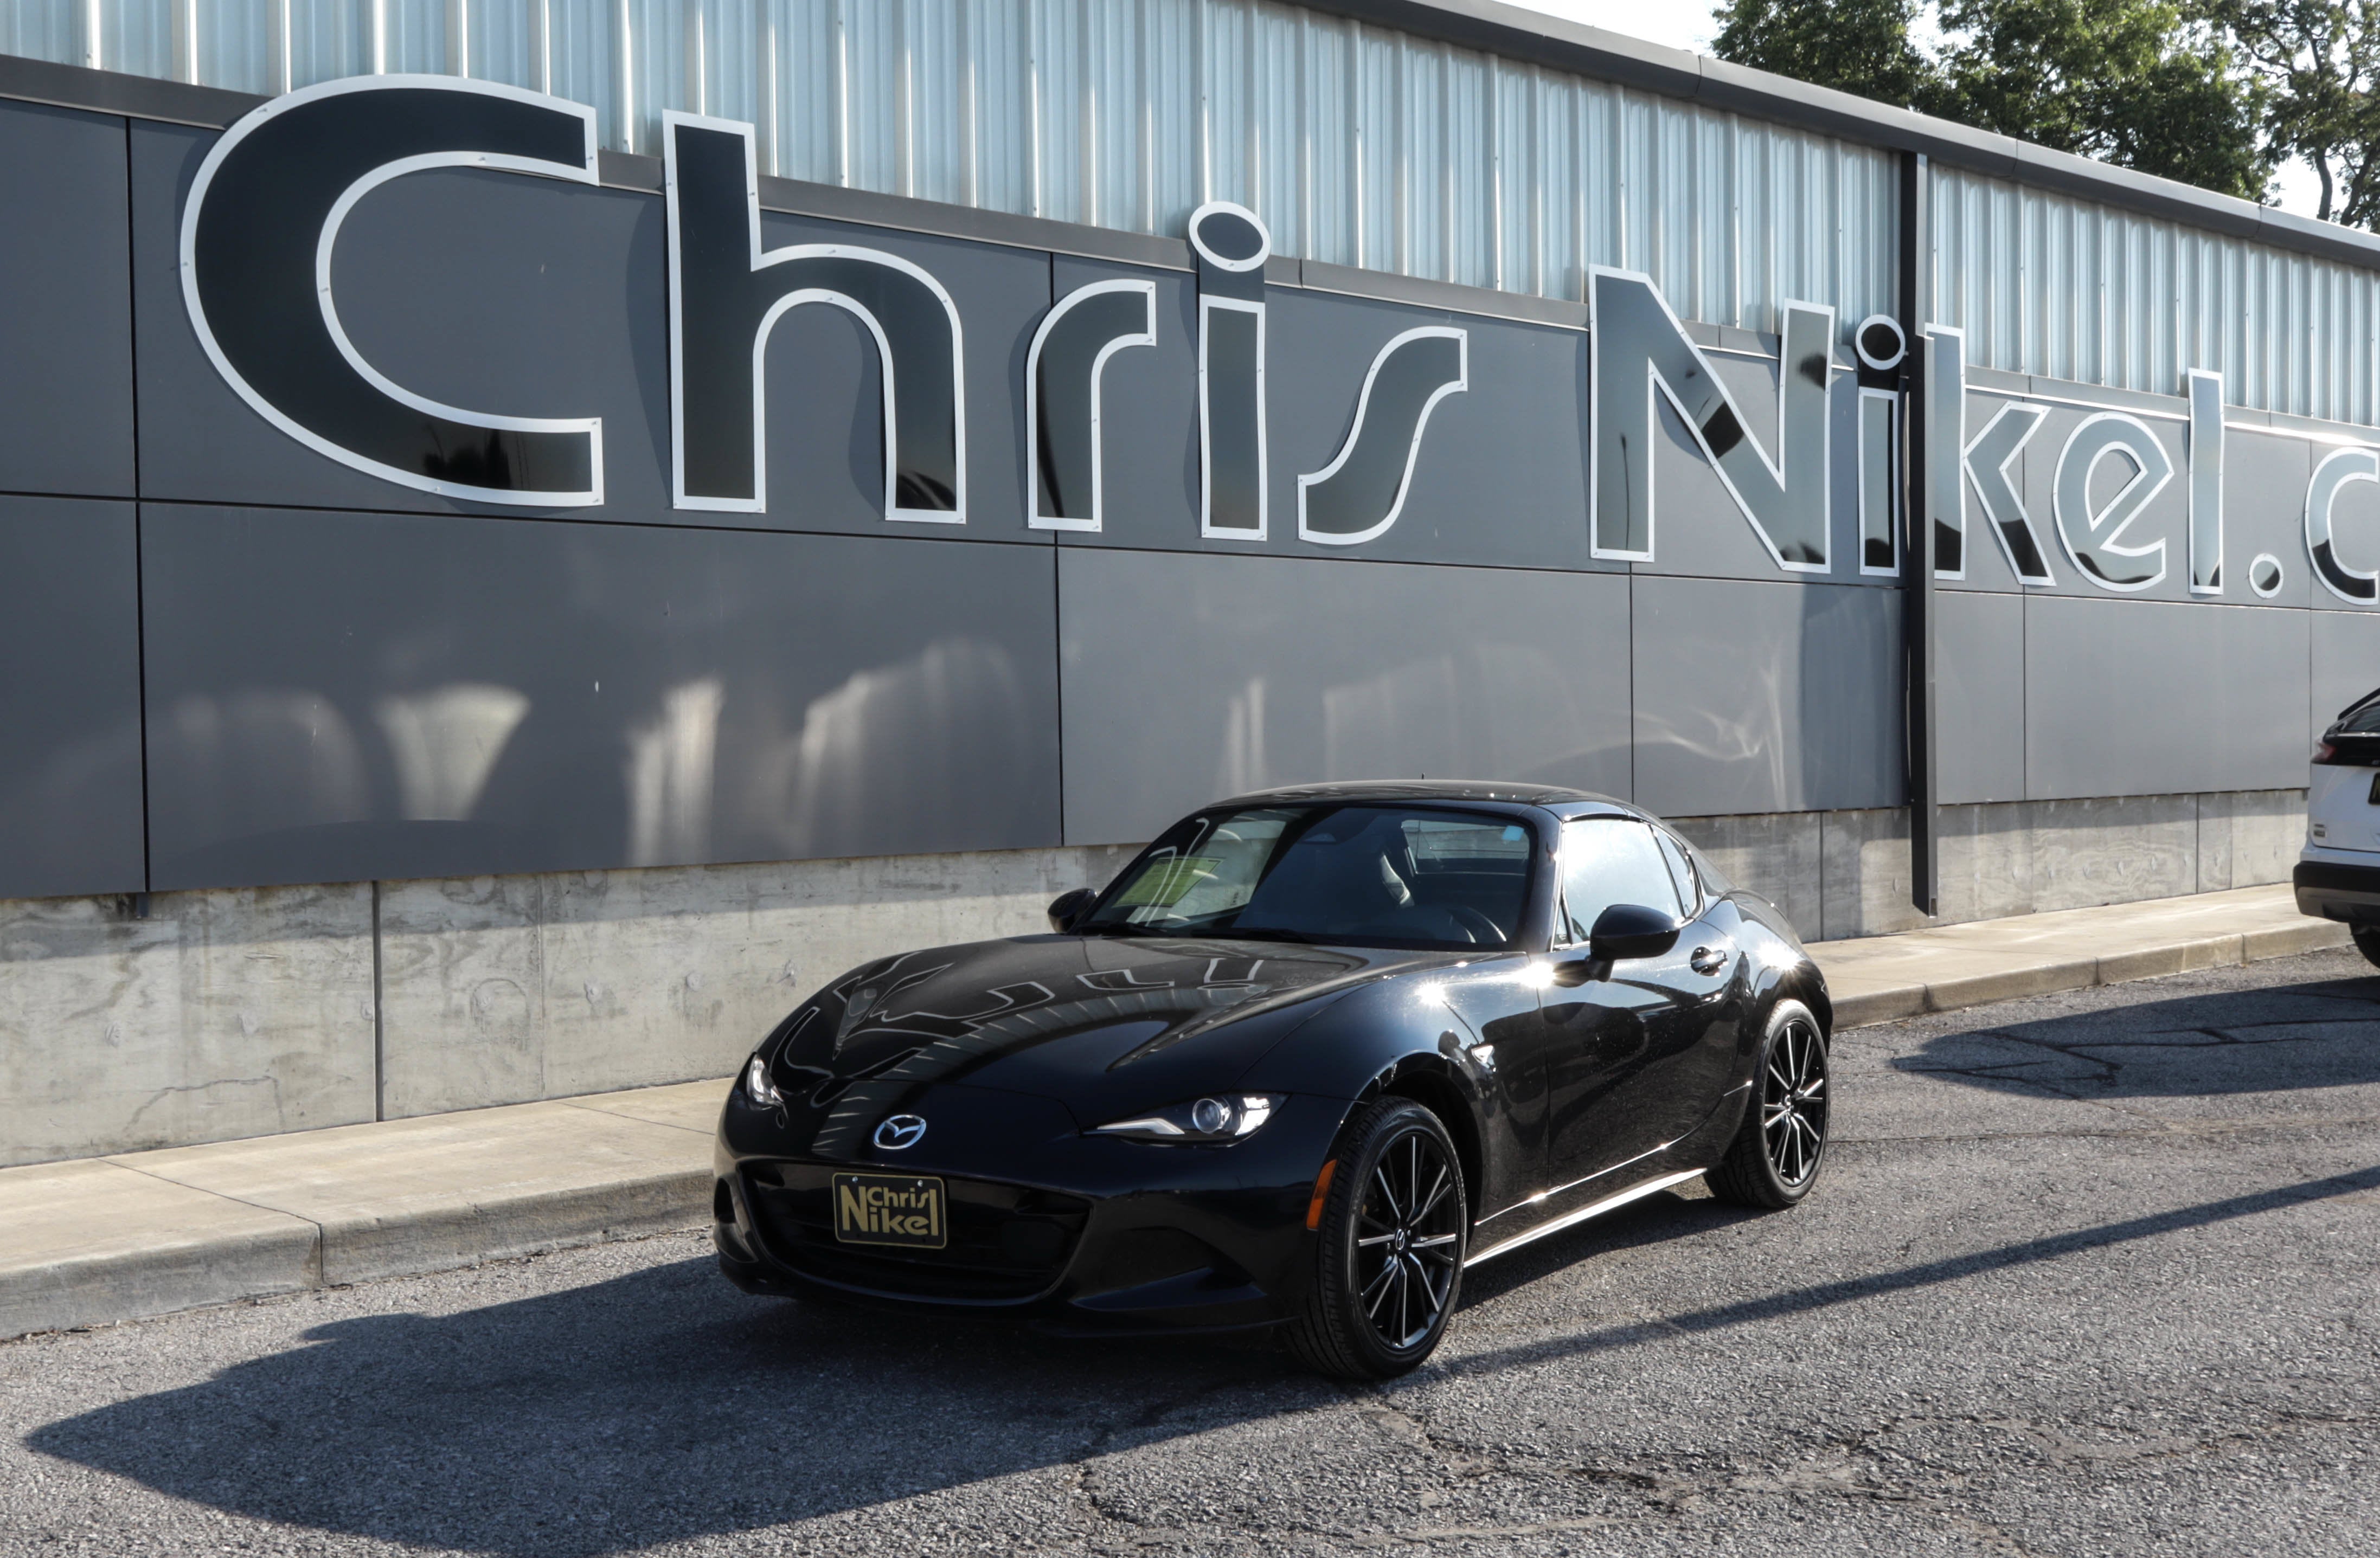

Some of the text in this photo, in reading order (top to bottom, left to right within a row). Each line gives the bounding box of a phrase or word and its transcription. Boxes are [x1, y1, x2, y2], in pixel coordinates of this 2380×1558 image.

[180, 74, 1467, 545] Chris
[841, 1185, 939, 1236] Nikel
[867, 1186, 929, 1208] Chris
